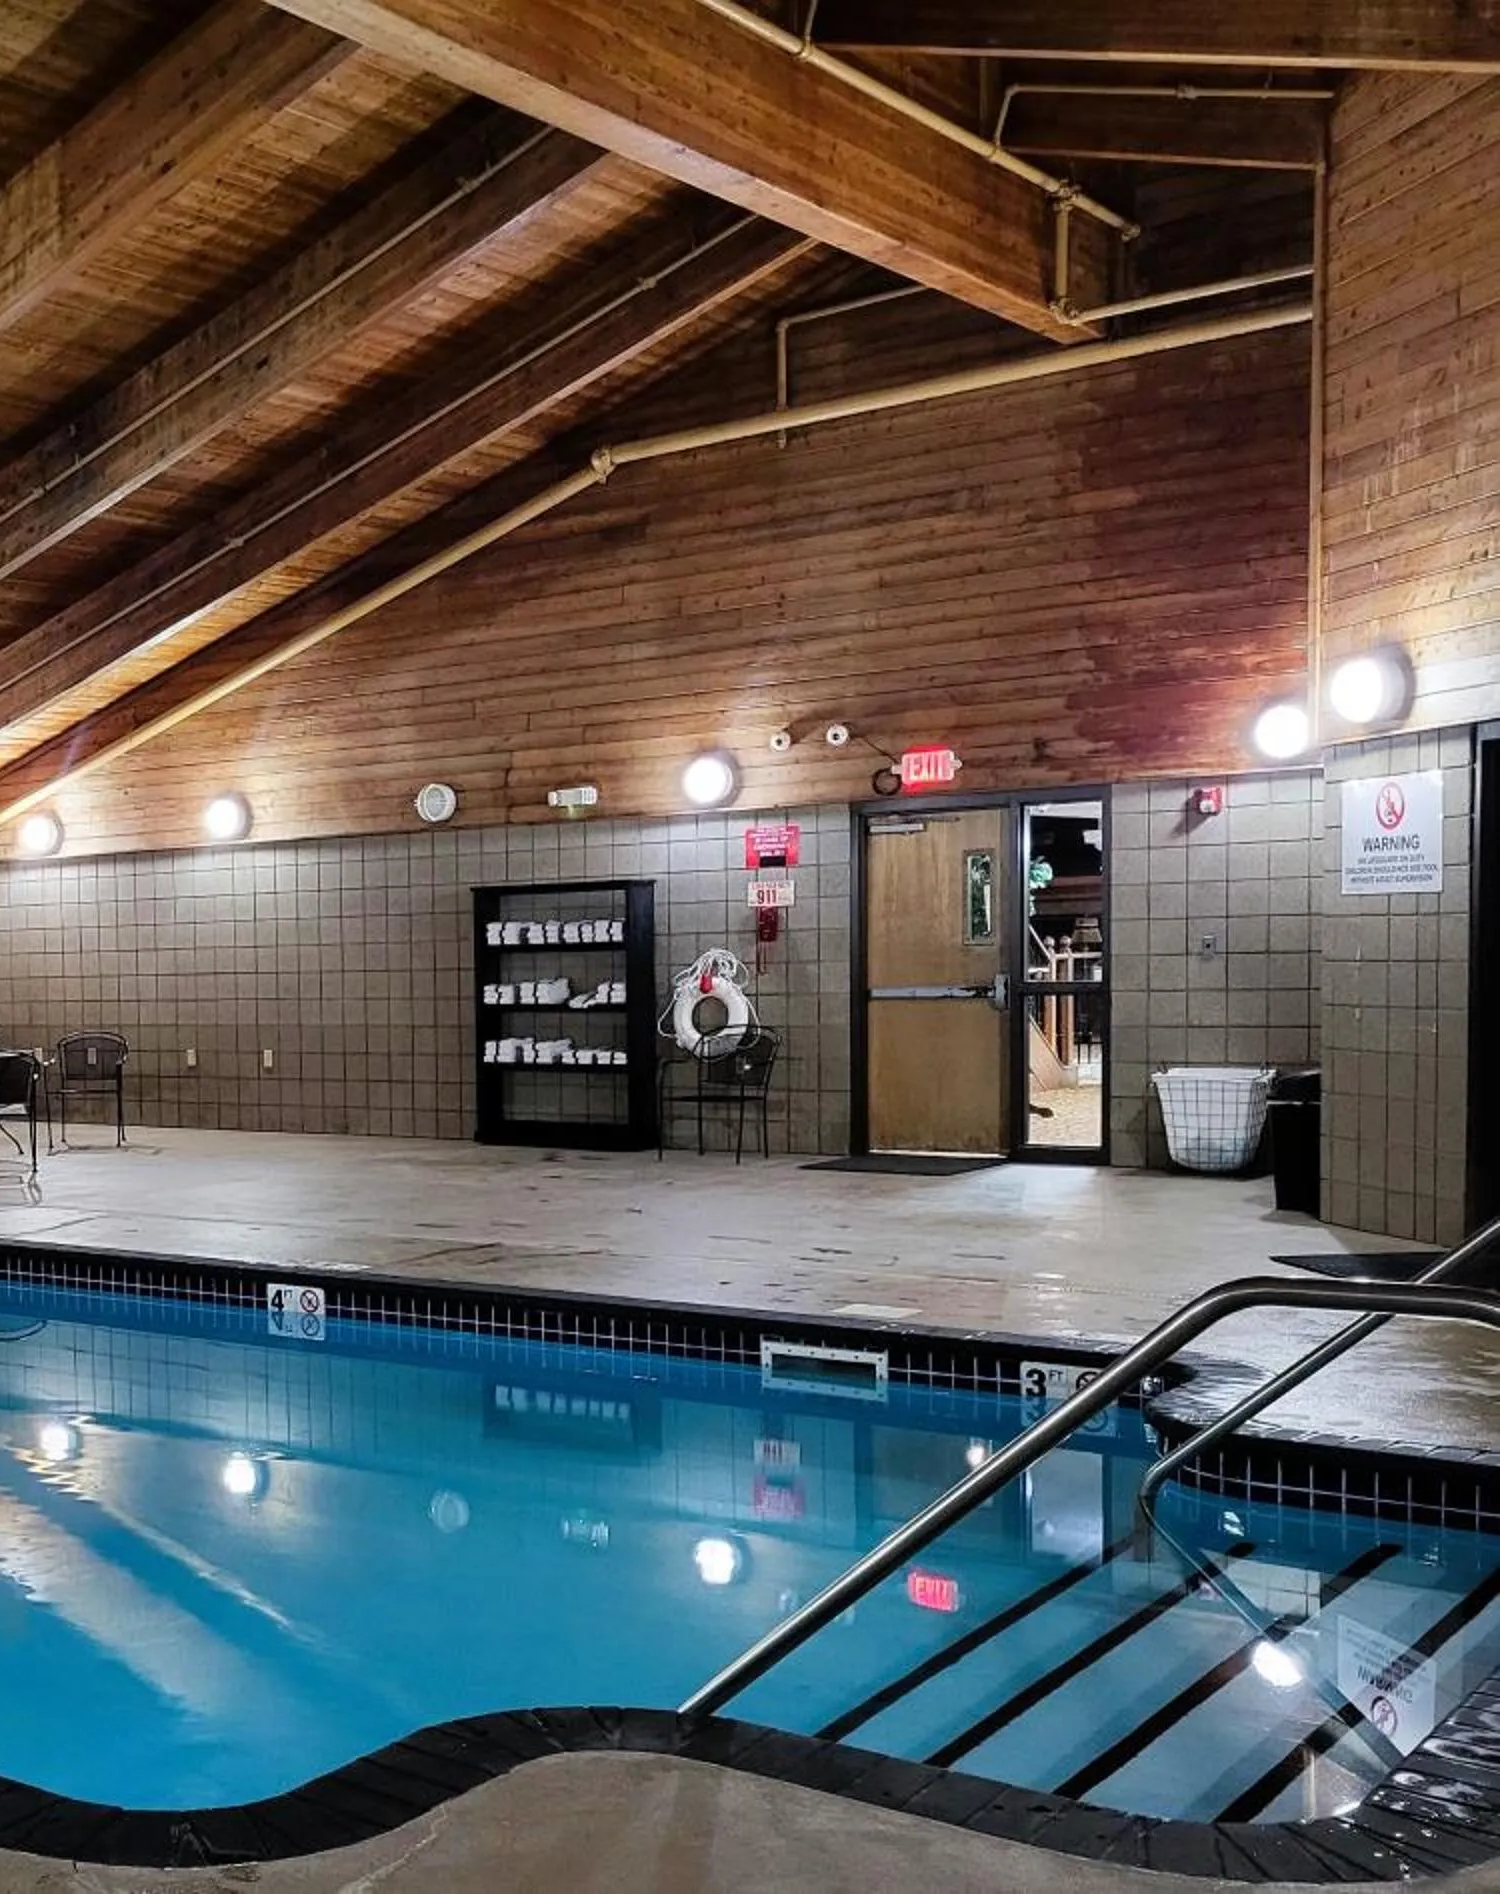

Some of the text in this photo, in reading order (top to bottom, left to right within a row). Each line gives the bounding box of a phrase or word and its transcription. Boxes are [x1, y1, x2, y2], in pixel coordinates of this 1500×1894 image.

[908, 751, 950, 780] EXIT
[1362, 834, 1421, 852] WARNING
[757, 889, 777, 905] 911
[271, 1289, 284, 1312] 4
[1026, 1368, 1064, 1398] 3 FT
